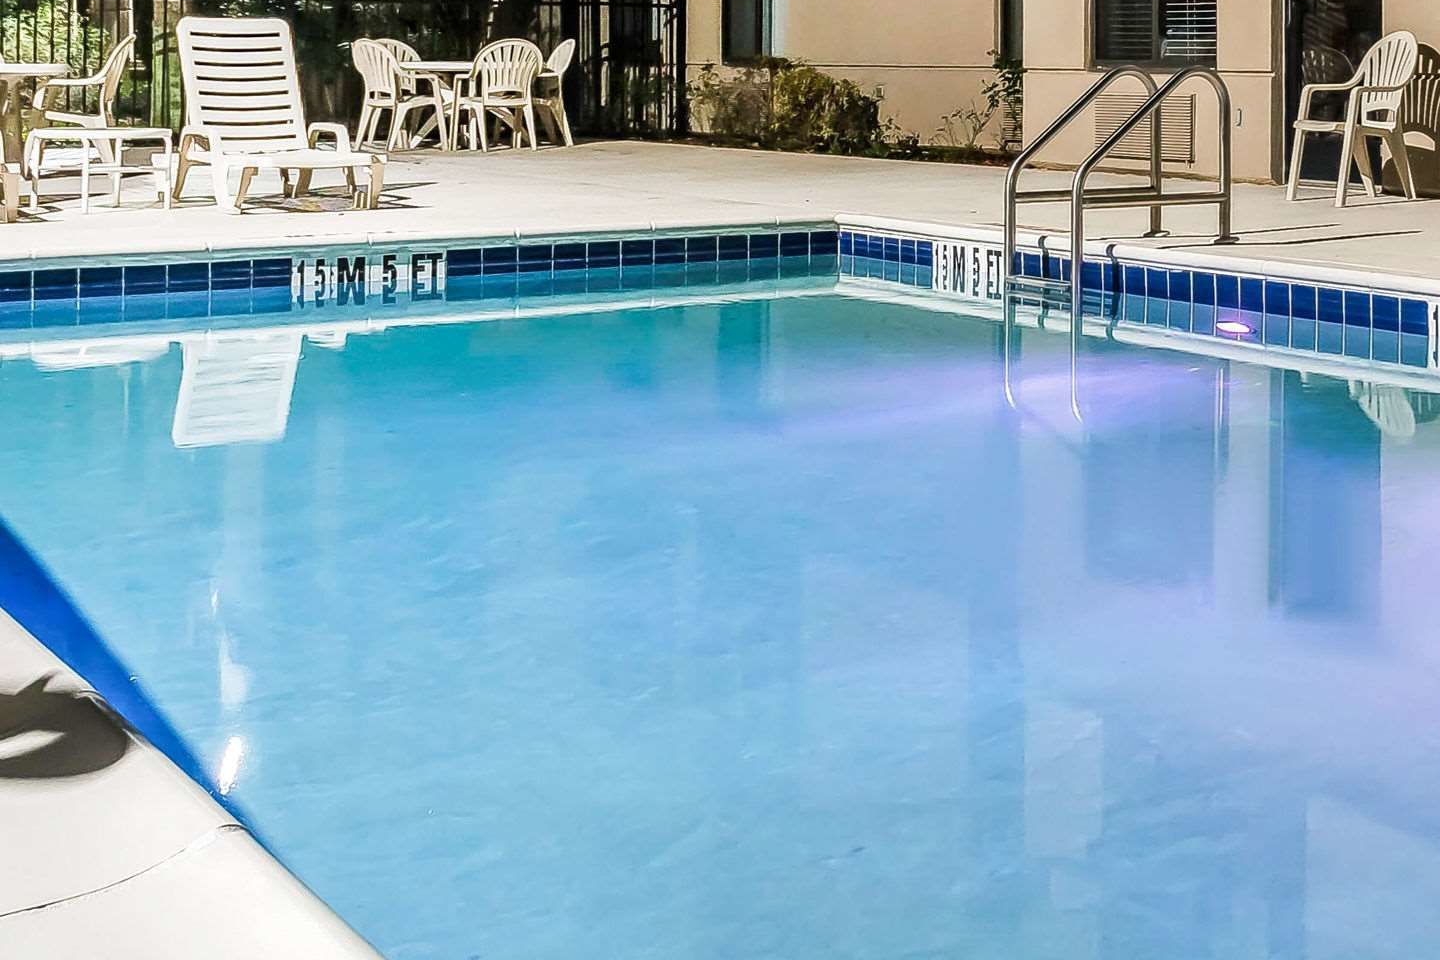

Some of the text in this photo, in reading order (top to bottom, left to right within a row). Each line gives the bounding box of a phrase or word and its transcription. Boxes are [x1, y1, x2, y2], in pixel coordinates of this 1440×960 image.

[336, 256, 366, 283] M
[382, 254, 397, 281] 5
[411, 252, 443, 279] FT
[986, 249, 1002, 276] FT
